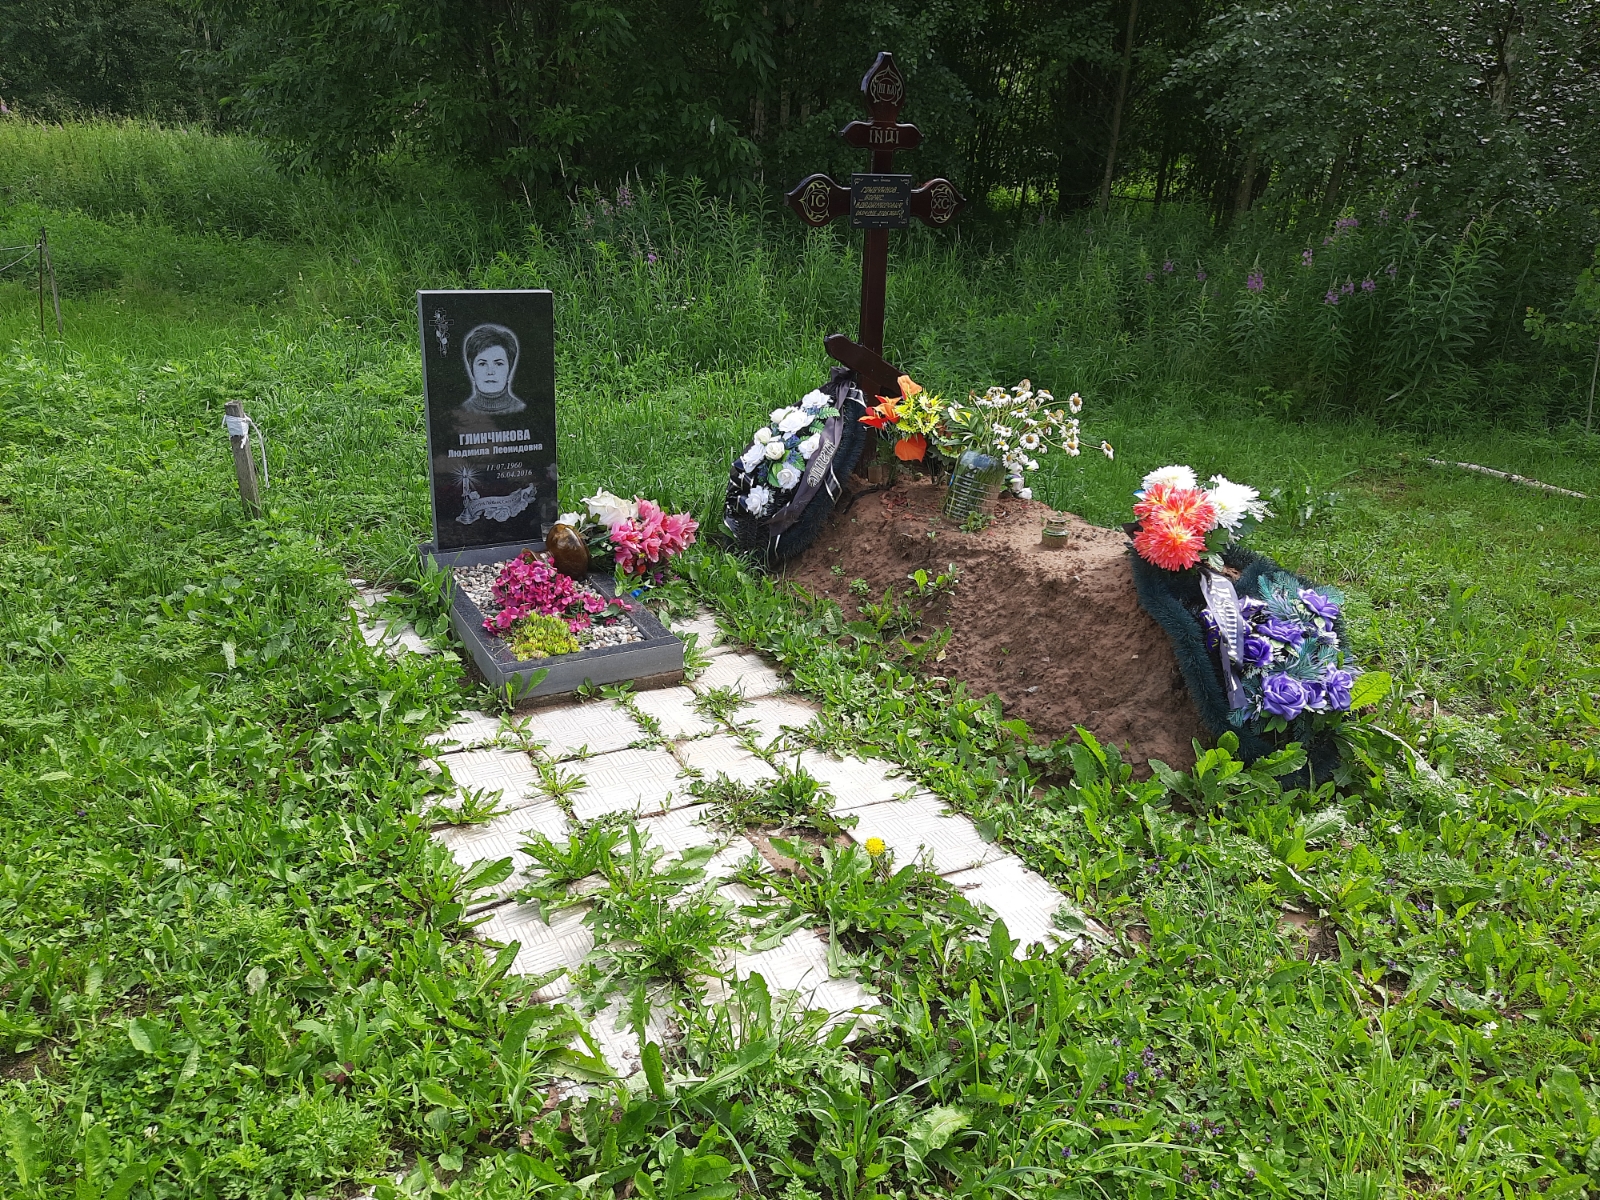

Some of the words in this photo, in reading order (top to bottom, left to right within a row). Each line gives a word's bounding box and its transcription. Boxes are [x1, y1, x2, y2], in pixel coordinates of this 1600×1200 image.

[459, 429, 531, 446] ГЛИНЧИКОВА
[447, 447, 490, 458] Людмила
[492, 443, 543, 455] Леонидовна
[486, 461, 523, 471] 11.07.1960
[496, 470, 533, 479] 26.04.2016
